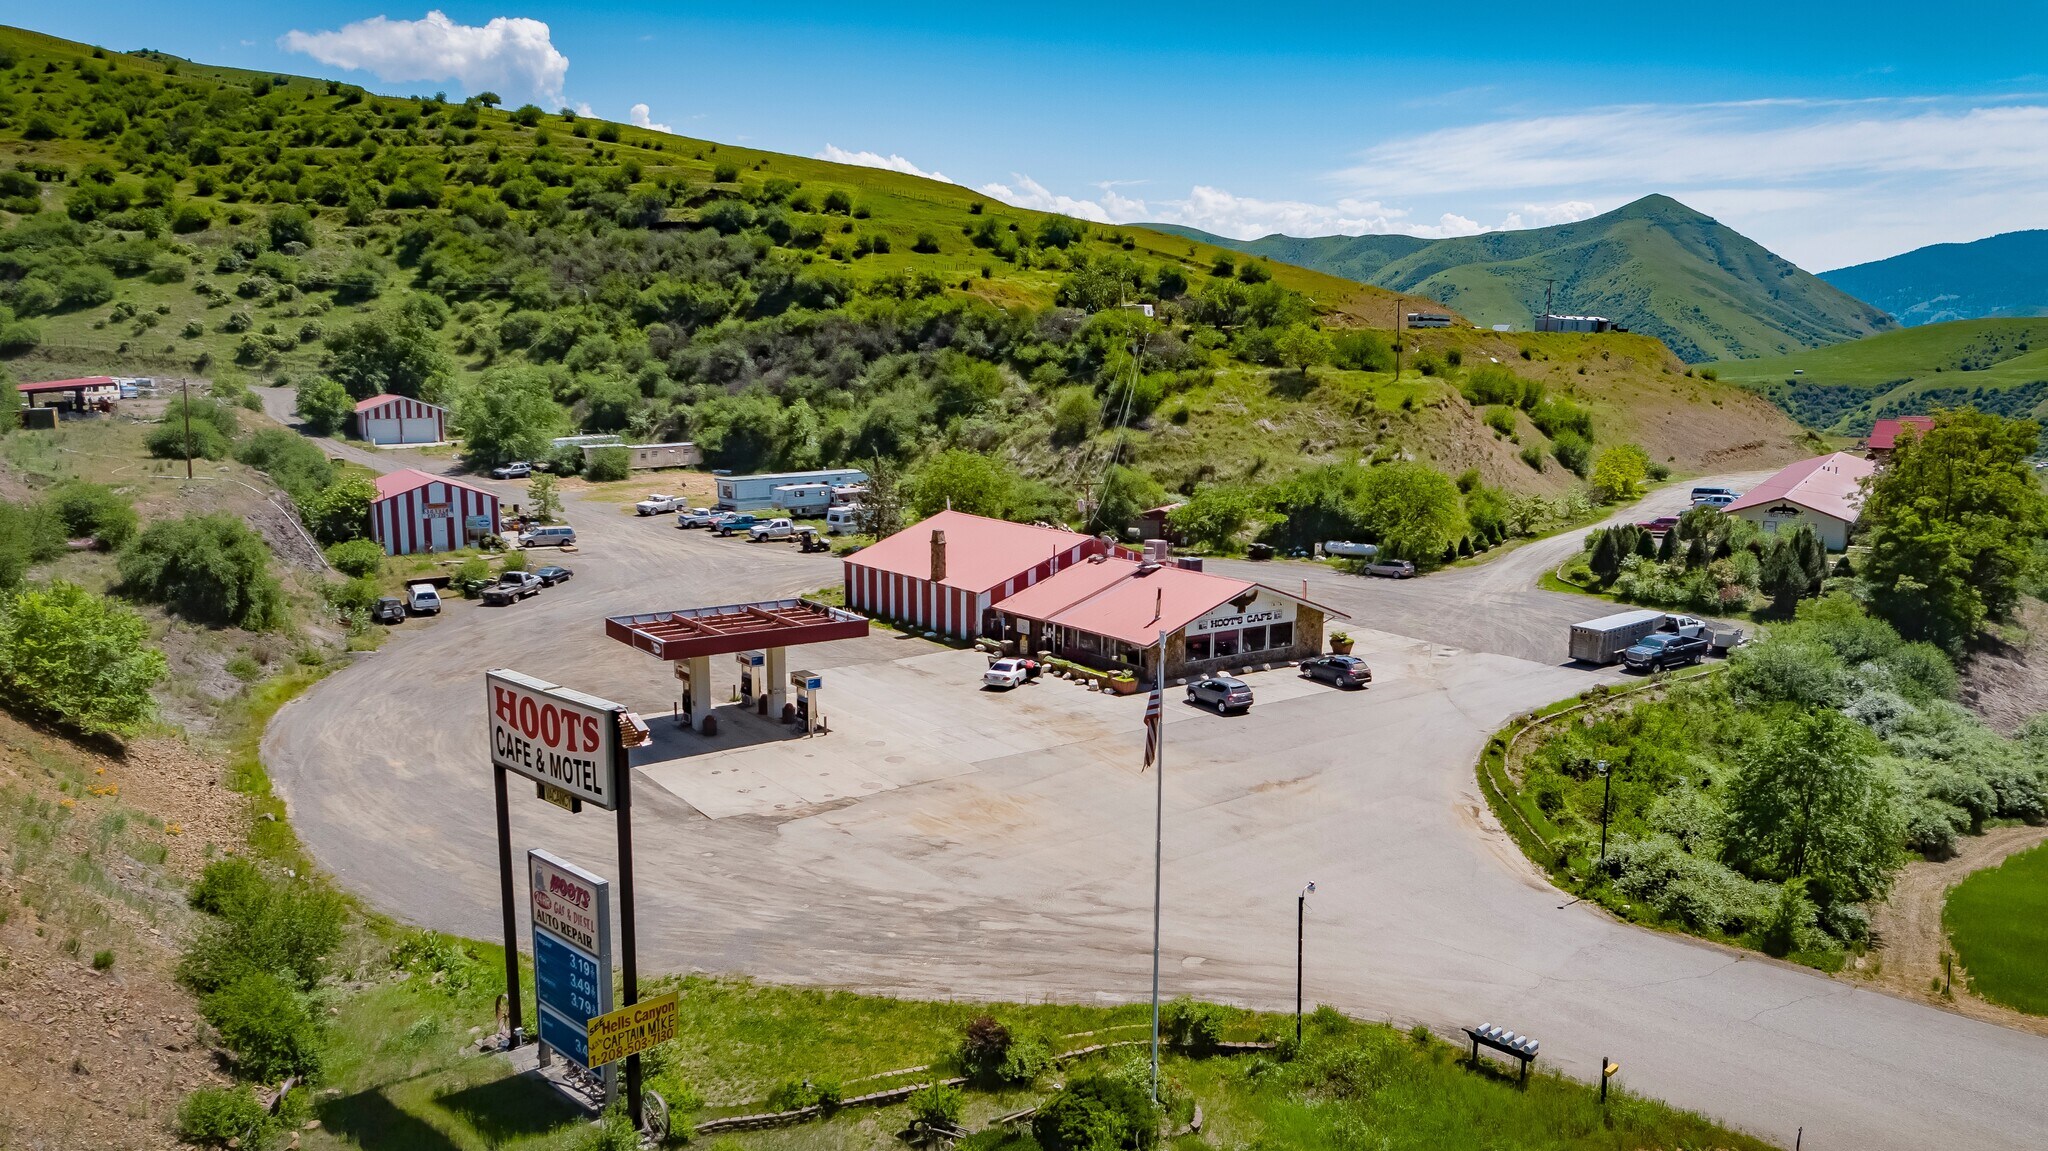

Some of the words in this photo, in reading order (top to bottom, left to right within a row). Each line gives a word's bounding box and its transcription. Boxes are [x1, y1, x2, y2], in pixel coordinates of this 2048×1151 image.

[1247, 612, 1272, 624] CAFE
[494, 685, 600, 753] HOOTS
[496, 725, 532, 768] CAFE
[536, 747, 545, 774] &
[550, 752, 602, 796] MOTEL
[550, 874, 591, 908] HOOTS
[536, 909, 559, 931] AUTO
[560, 920, 593, 949] REPAIR
[554, 901, 565, 916] GAS
[567, 909, 572, 922] &
[573, 911, 595, 933] DIESEL
[569, 953, 590, 976] 3.19
[570, 973, 591, 996] 3.49
[570, 992, 592, 1015] 3.79
[589, 1016, 605, 1037] SEE
[601, 1015, 631, 1036] Hells
[634, 1001, 675, 1024] Canyon
[575, 1039, 589, 1058] 3.4
[590, 1028, 674, 1067] 1-208-503-7130
[602, 1025, 645, 1050] CAPTAIN
[648, 1013, 675, 1036] MIKE
